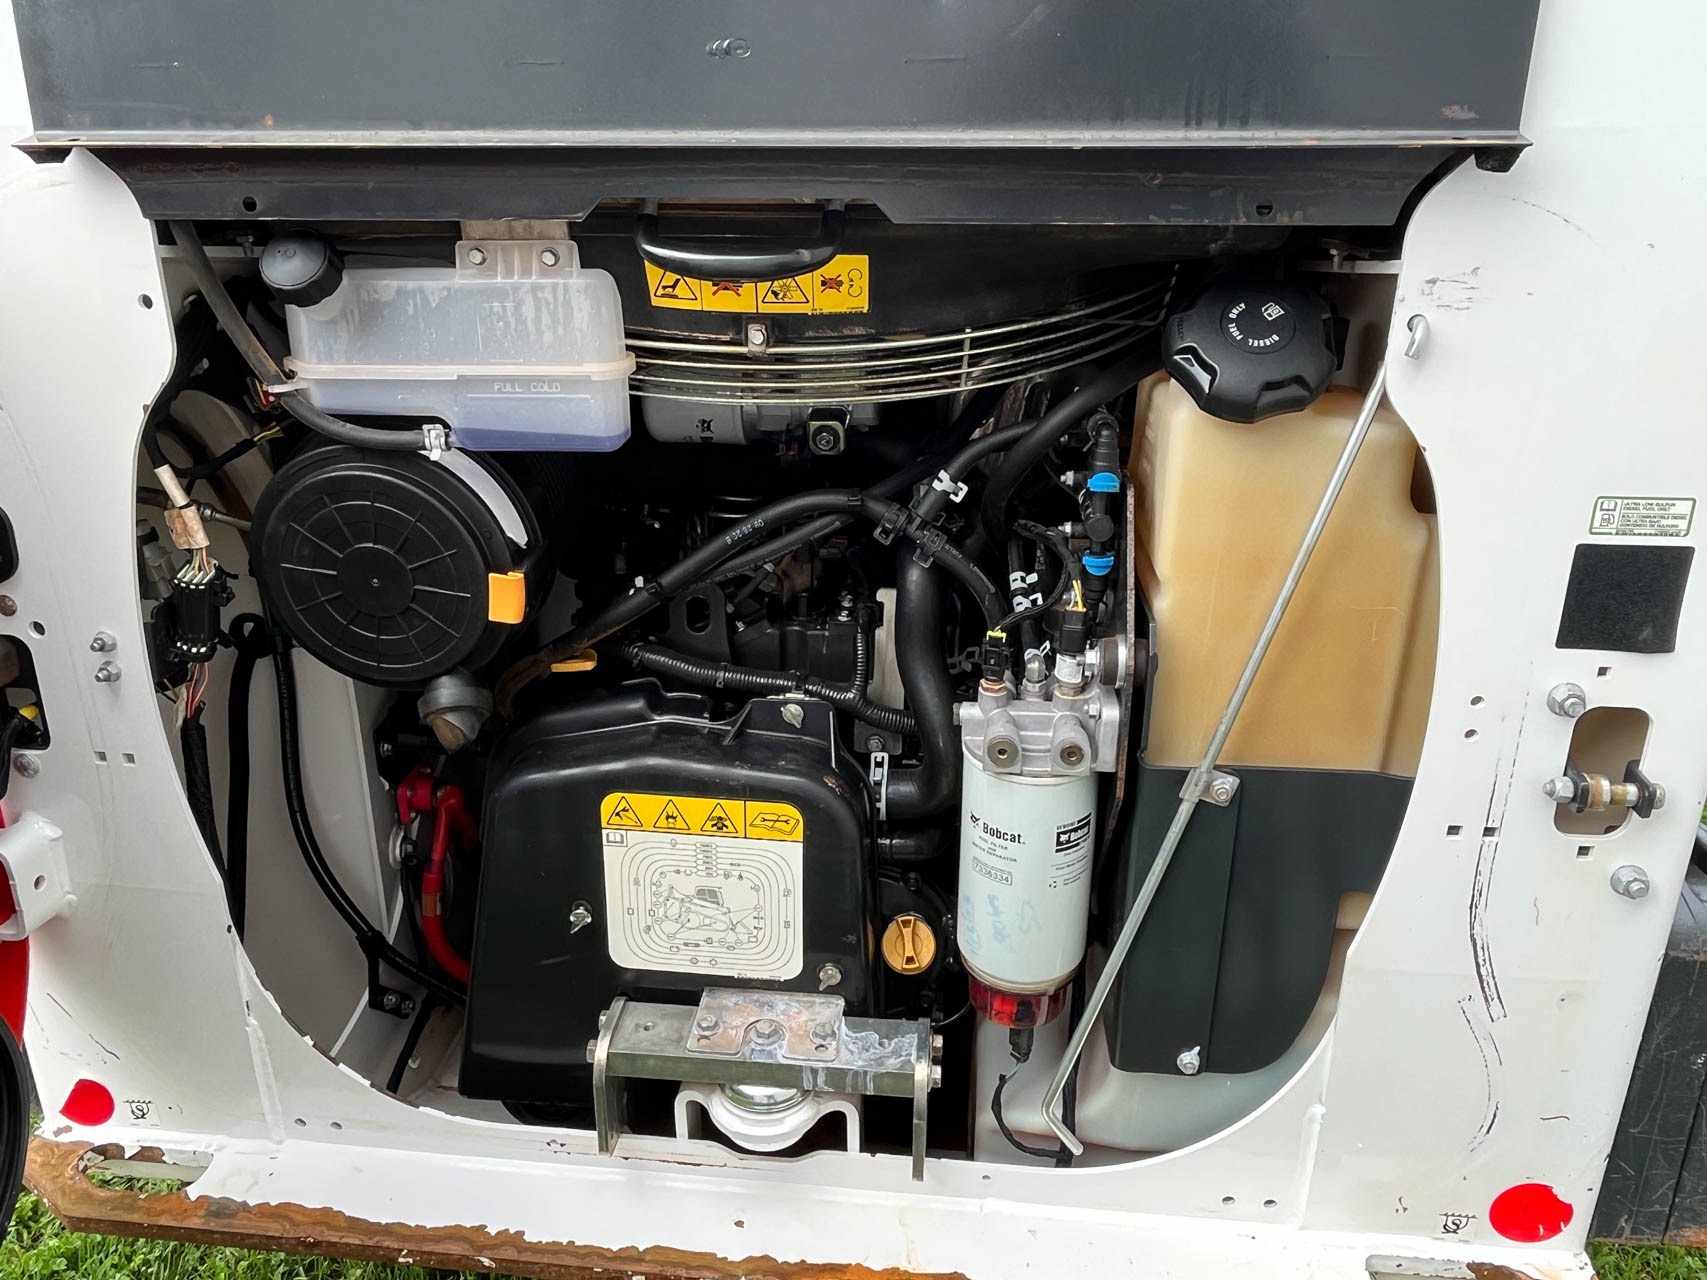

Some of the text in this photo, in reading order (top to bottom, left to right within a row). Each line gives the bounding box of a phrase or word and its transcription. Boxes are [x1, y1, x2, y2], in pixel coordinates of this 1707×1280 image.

[1228, 302, 1280, 347] DIESEL FUEL ONLY
[494, 382, 561, 392] FULL COLD
[982, 821, 1022, 845] Bobcat
